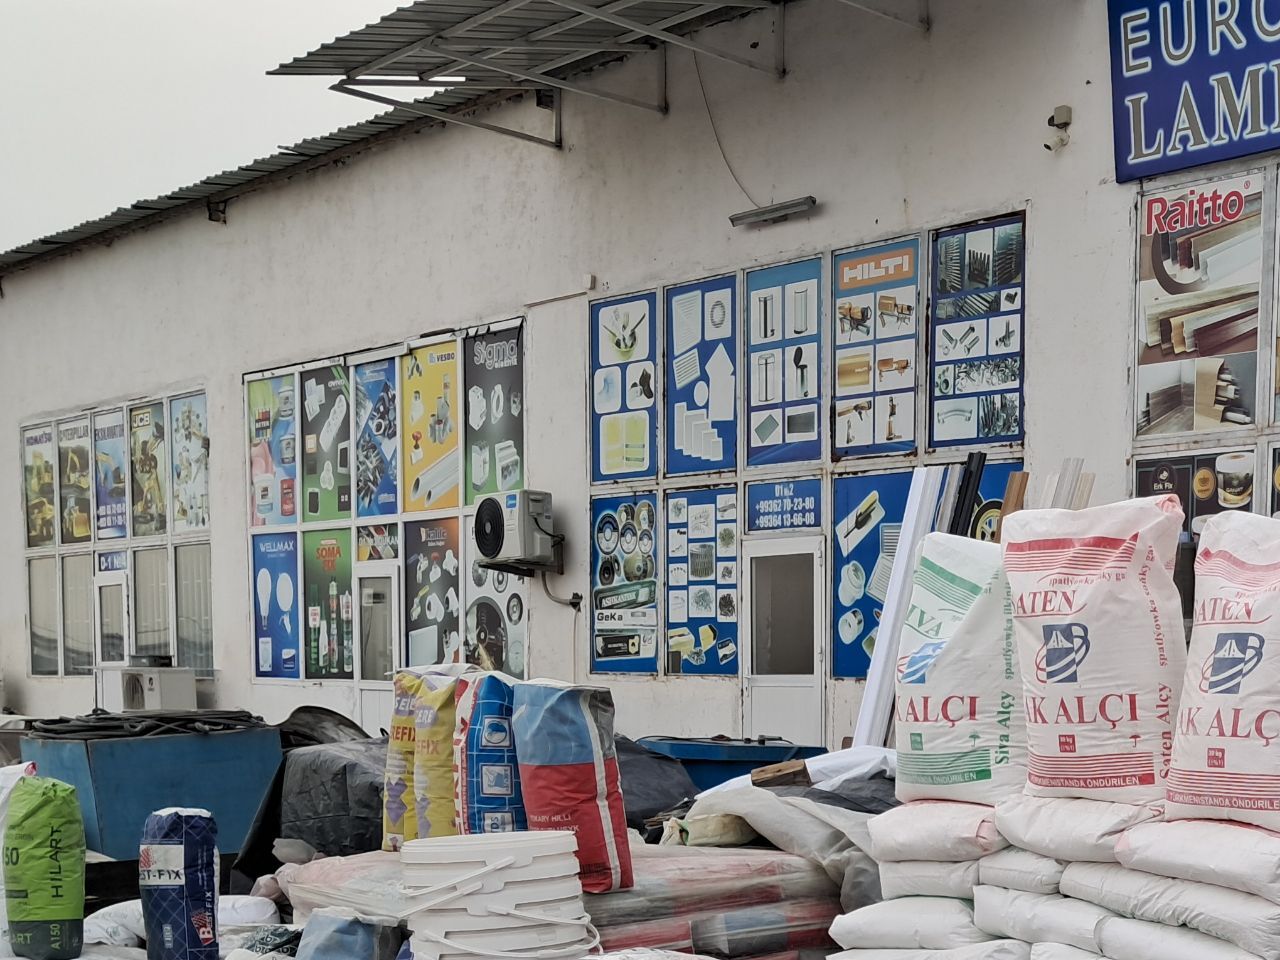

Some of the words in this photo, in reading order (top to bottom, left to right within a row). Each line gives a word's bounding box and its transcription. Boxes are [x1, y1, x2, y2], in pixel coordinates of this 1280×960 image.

[1146, 188, 1246, 236] Raitto
[843, 254, 909, 284] HILTI
[474, 339, 518, 368] Sigma
[132, 414, 151, 428] JCB
[259, 540, 295, 553] WELLMAX
[906, 695, 980, 727] ALÇI
[995, 690, 1016, 731] Alçy
[1055, 692, 1142, 730] ALÇI
[1155, 682, 1173, 724] Alçy
[1158, 730, 1174, 780] Saten
[49, 825, 64, 899] HILART
